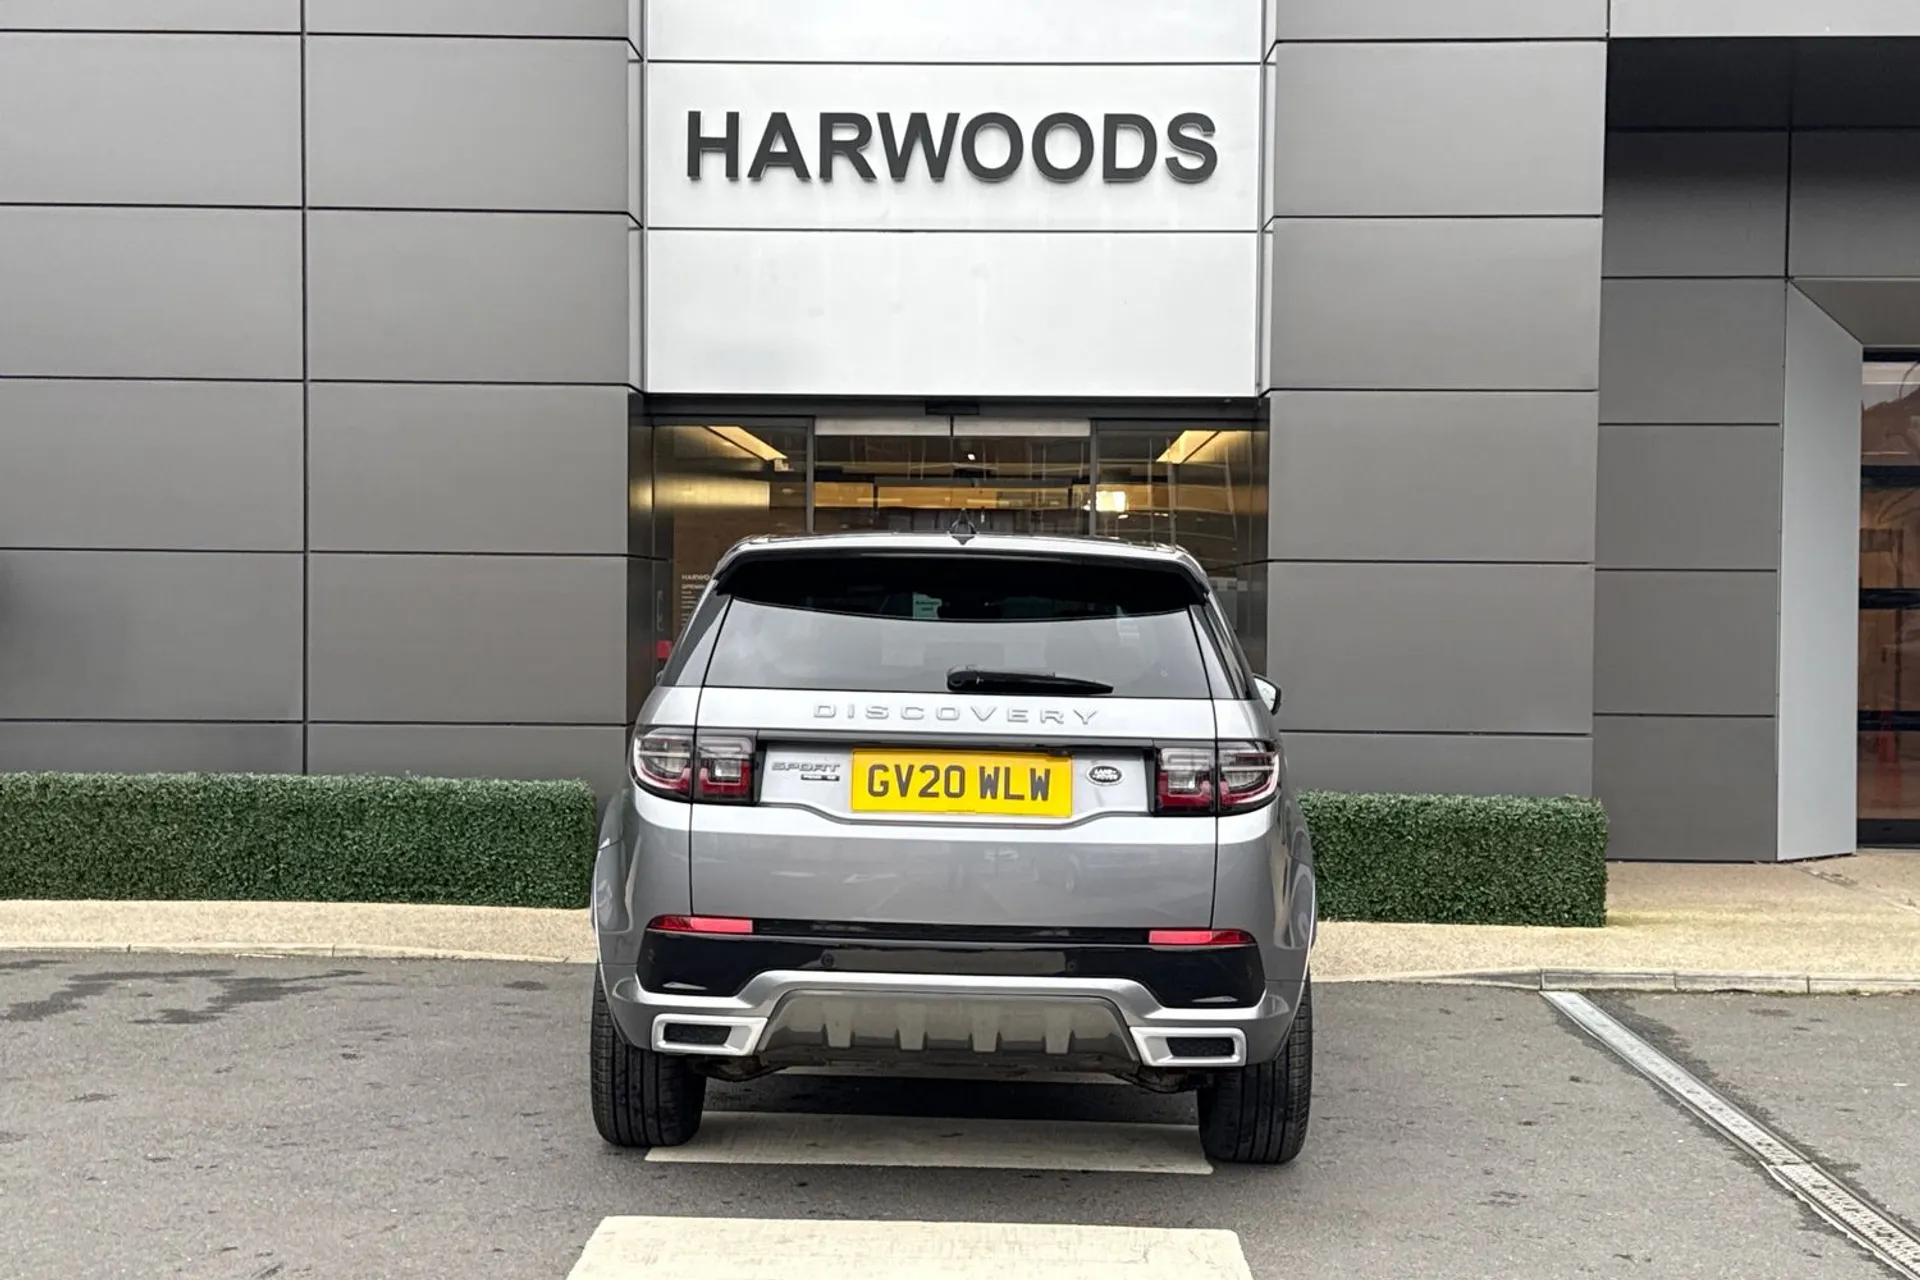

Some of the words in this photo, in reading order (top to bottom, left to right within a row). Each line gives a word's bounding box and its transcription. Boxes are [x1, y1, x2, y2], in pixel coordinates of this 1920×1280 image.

[686, 110, 1218, 184] HARWOODS
[813, 703, 1098, 726] DISCOVERY
[772, 762, 841, 772] SPORT
[867, 763, 966, 799] GV20
[979, 765, 1052, 802] WLW
